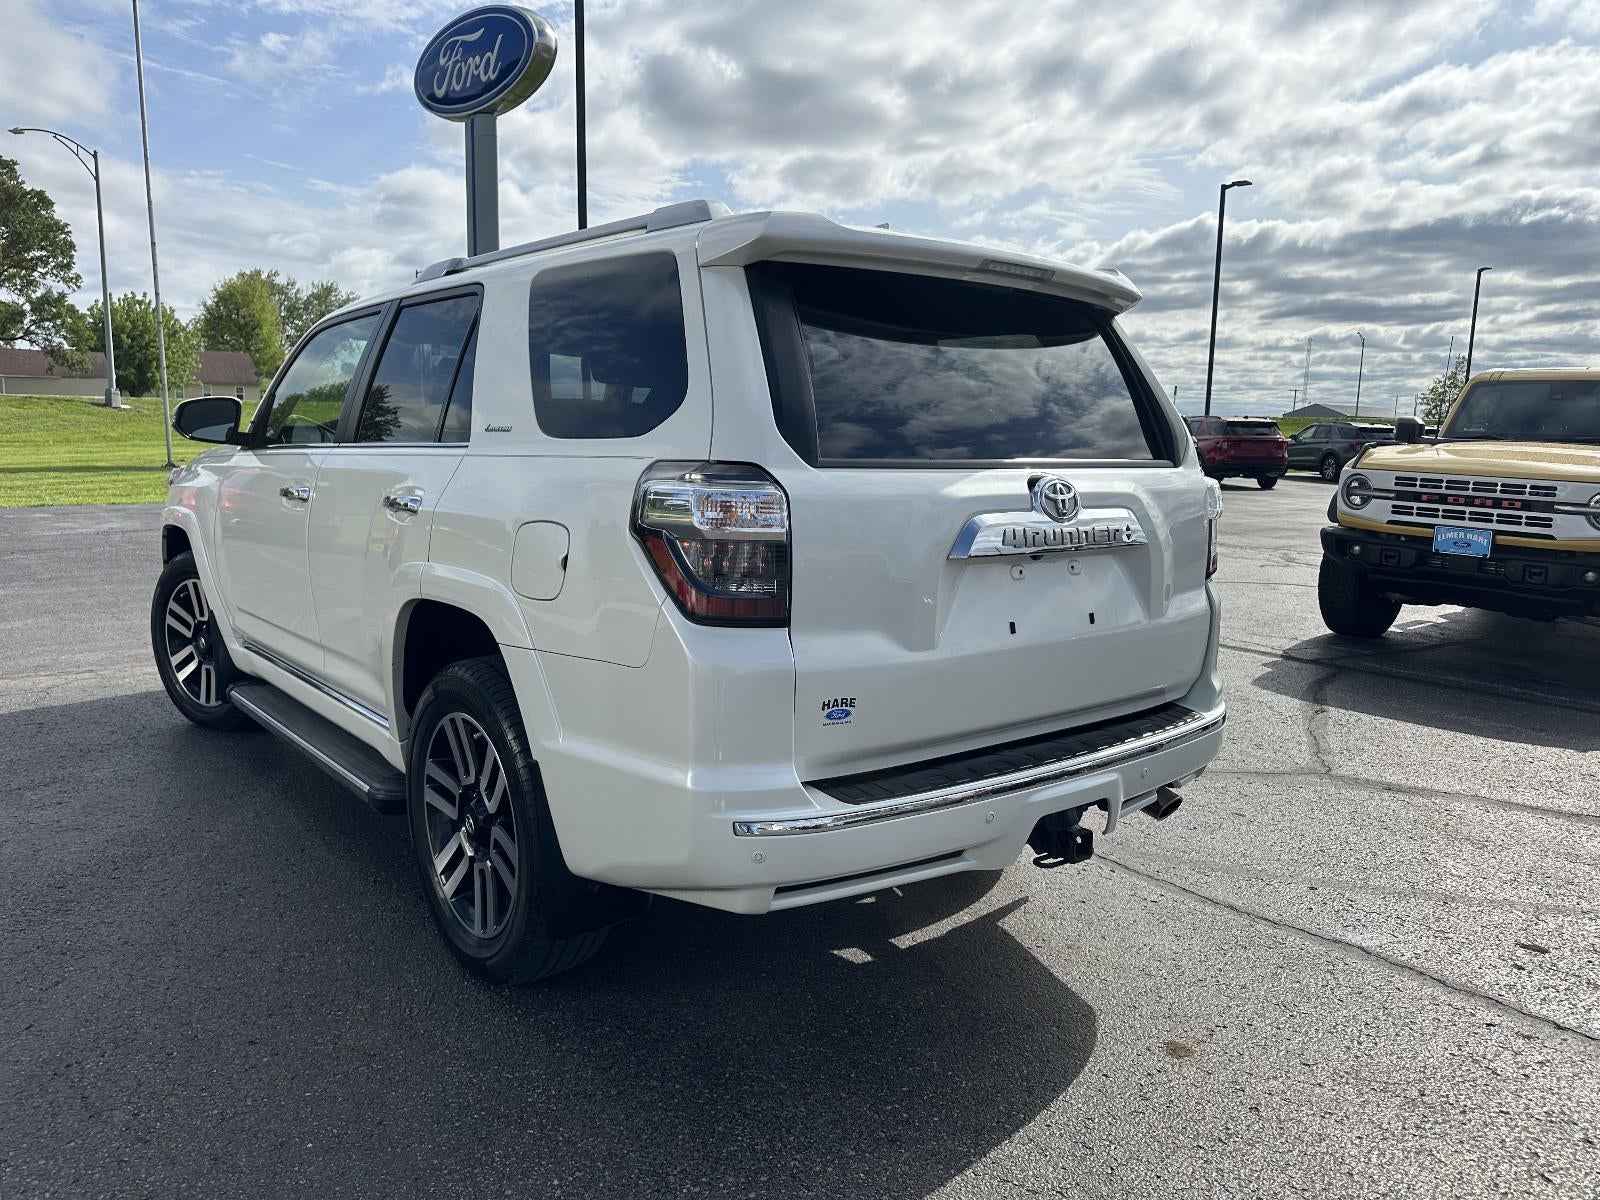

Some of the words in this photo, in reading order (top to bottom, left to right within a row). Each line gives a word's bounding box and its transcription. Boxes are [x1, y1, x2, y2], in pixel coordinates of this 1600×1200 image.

[433, 27, 503, 98] Ford
[1421, 494, 1521, 508] FORD
[1437, 531, 1465, 541] ELMER
[1466, 532, 1489, 546] HARE
[821, 697, 857, 711] HARE
